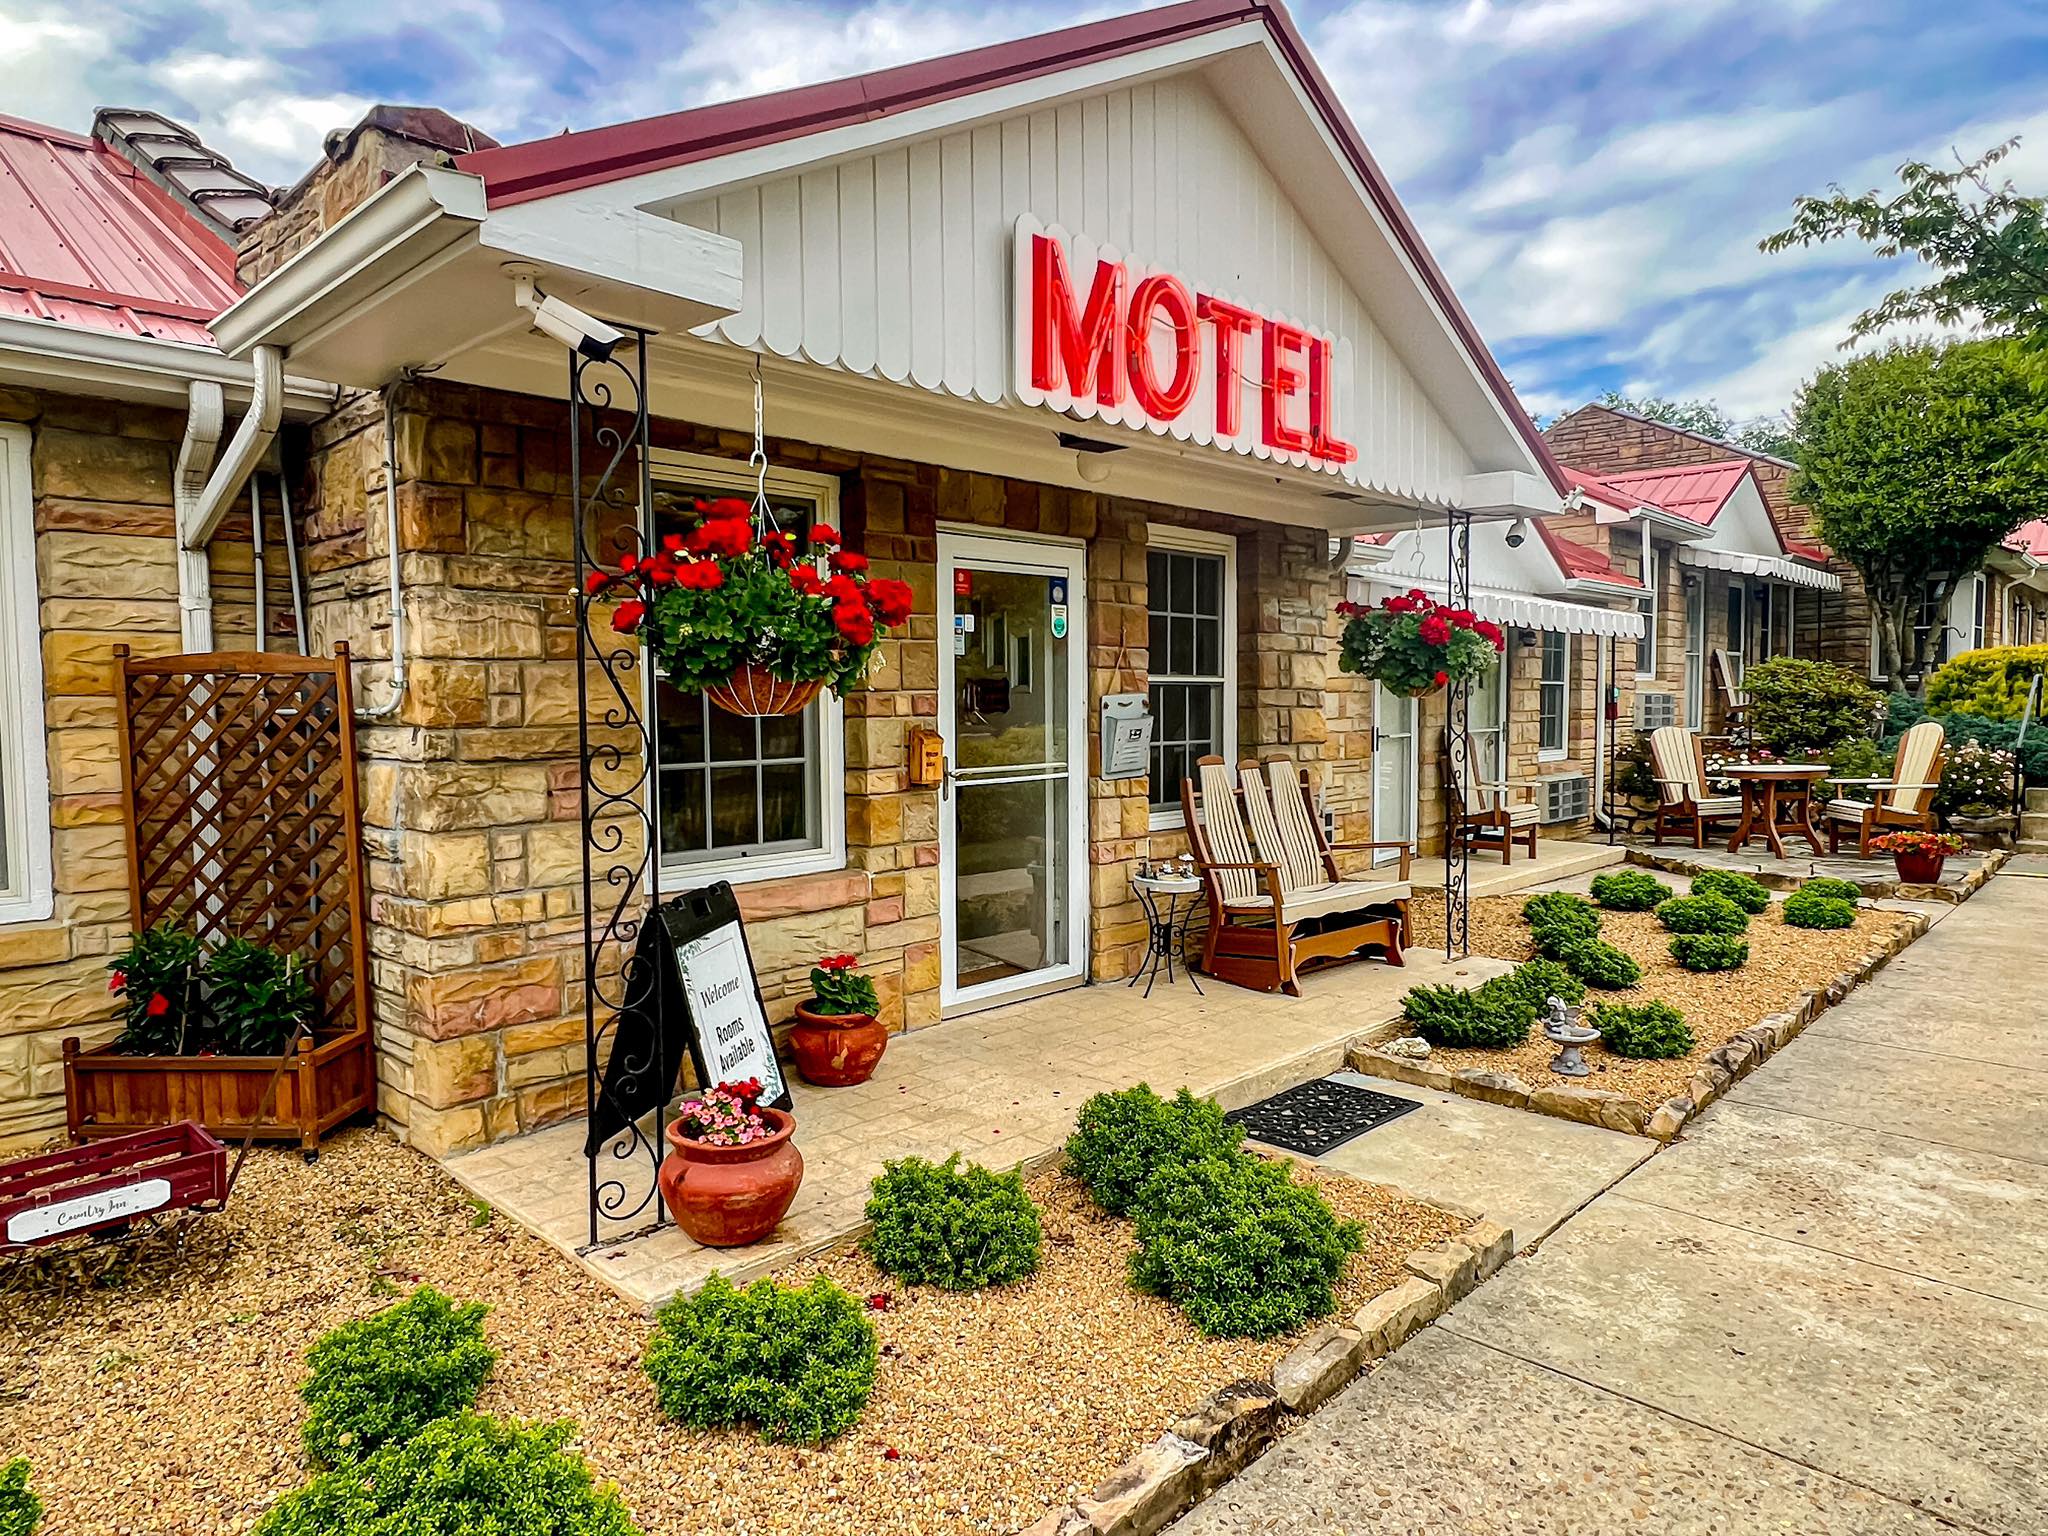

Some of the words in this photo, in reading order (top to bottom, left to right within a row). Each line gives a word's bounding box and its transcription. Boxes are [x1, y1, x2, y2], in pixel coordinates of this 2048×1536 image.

[1032, 233, 1358, 464] MOTEL
[700, 976, 740, 1009] Welcome
[715, 1017, 745, 1046] Rooms
[719, 1038, 756, 1075] Available
[57, 1205, 105, 1226] Country
[108, 1195, 127, 1212] Inn
